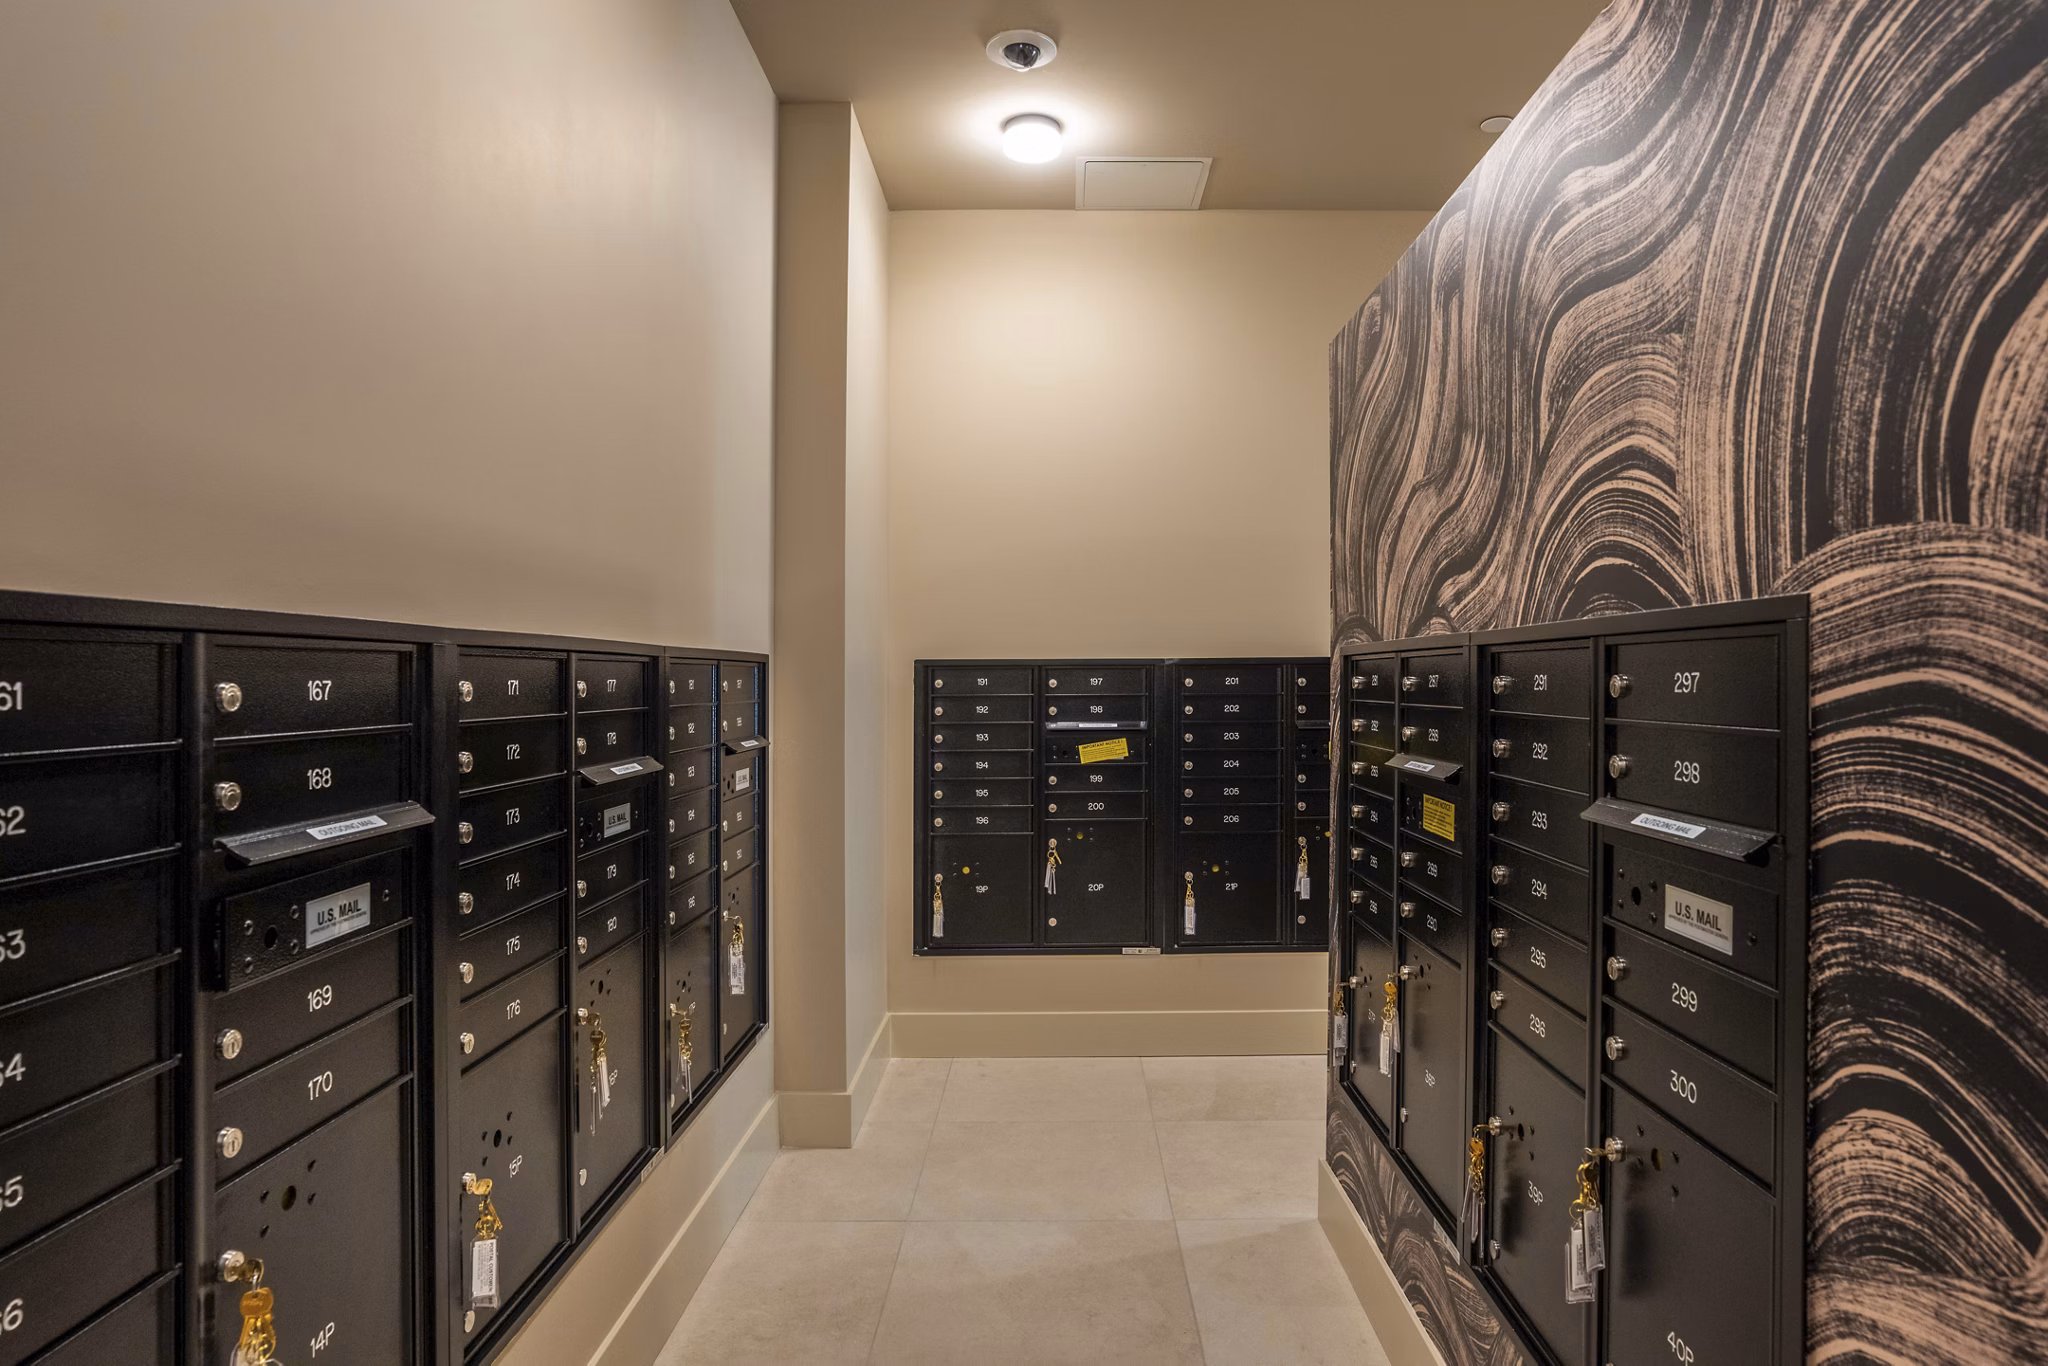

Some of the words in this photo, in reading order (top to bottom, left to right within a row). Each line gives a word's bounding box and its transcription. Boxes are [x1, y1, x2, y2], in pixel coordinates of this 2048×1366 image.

[308, 680, 331, 701] 167
[507, 680, 519, 696] 171
[606, 680, 617, 692] 177
[977, 677, 988, 686] 191
[1089, 677, 1104, 686] 197
[1533, 675, 1548, 691] 291
[1675, 672, 1699, 693] 297
[975, 705, 989, 714] 192
[1089, 705, 1104, 714] 198
[1223, 704, 1240, 713] 202
[606, 732, 617, 746] 178
[975, 733, 989, 742] 193
[1223, 732, 1240, 741] 203
[506, 744, 521, 761] 172
[1532, 743, 1548, 761] 292
[975, 761, 989, 770] 194
[1223, 759, 1240, 768] 204
[1674, 761, 1699, 783] 298
[307, 768, 331, 789] 168
[1089, 774, 1103, 783] 199
[975, 788, 989, 798] 195
[1223, 787, 1240, 796] 205
[1087, 802, 1105, 811] 200
[505, 808, 521, 826] 173
[616, 812, 627, 823] MAIL
[975, 816, 989, 825] 196
[1223, 814, 1240, 823] 206
[1531, 811, 1548, 830] 293
[1640, 817, 1675, 831] OUTGOING
[1675, 825, 1692, 835] MAIL
[318, 821, 358, 836] OUTGOING
[359, 819, 377, 829] MAIL
[606, 864, 617, 880] 179
[505, 872, 521, 891] 174
[975, 885, 989, 894] 19P
[1087, 883, 1105, 892] 20P
[1225, 882, 1239, 891] 21P
[1531, 879, 1548, 900] 294
[317, 908, 337, 926] U.S.
[339, 899, 362, 918] MAIL
[1675, 901, 1694, 921] U.S.
[1696, 909, 1722, 932] MAIL
[506, 936, 521, 956] 175
[1530, 947, 1547, 969] 295
[308, 985, 332, 1012] 169
[1672, 983, 1697, 1012] 299
[506, 1000, 521, 1020] 176
[1529, 1014, 1546, 1038] 296
[0, 1053, 25, 1087] 4
[308, 1071, 332, 1100] 170
[1671, 1070, 1696, 1103] 300
[508, 1155, 523, 1178] 15P
[0, 1176, 22, 1211] 5
[1528, 1181, 1544, 1205] 39P
[0, 1299, 22, 1335] 6
[311, 1322, 334, 1358] 14P
[1667, 1332, 1694, 1366] 40P
